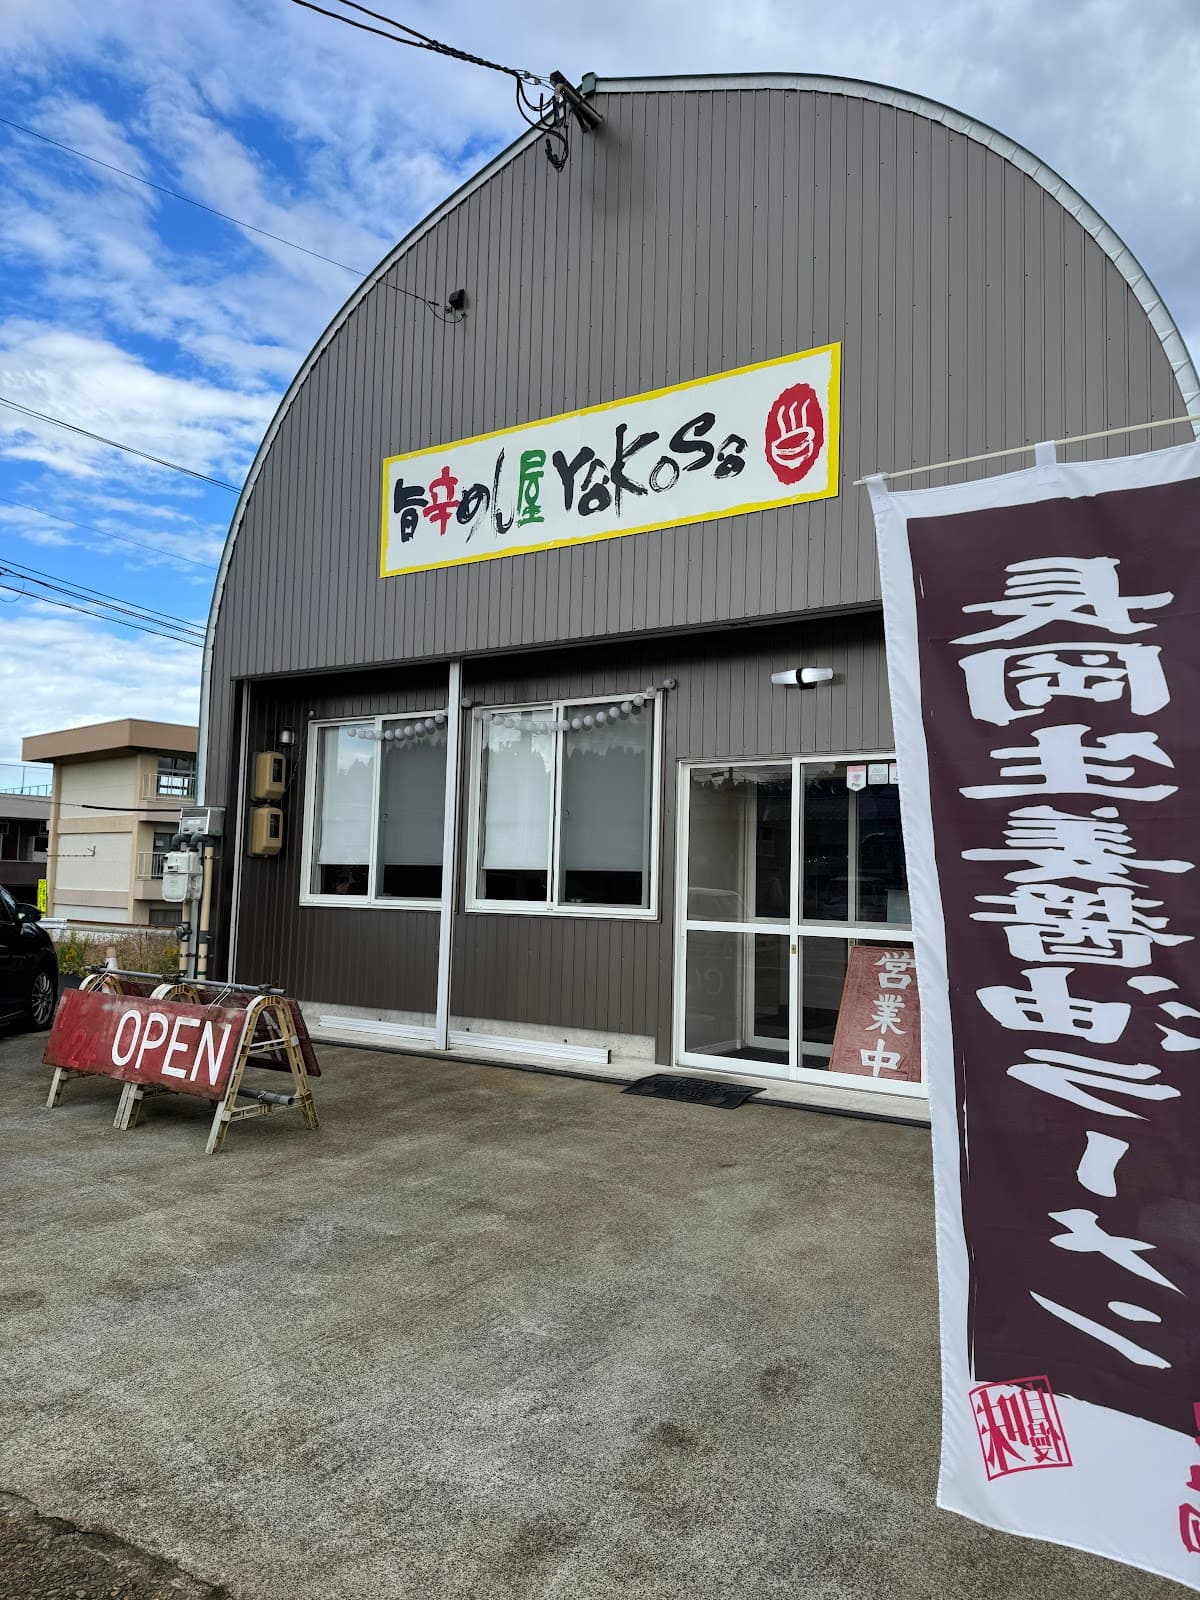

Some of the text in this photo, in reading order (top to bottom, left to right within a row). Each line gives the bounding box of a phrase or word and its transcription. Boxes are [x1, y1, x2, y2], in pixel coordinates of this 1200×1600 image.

[394, 448, 547, 544] 旨辛めし屋
[111, 1009, 232, 1087] OPEN
[860, 951, 916, 1078] 営業中
